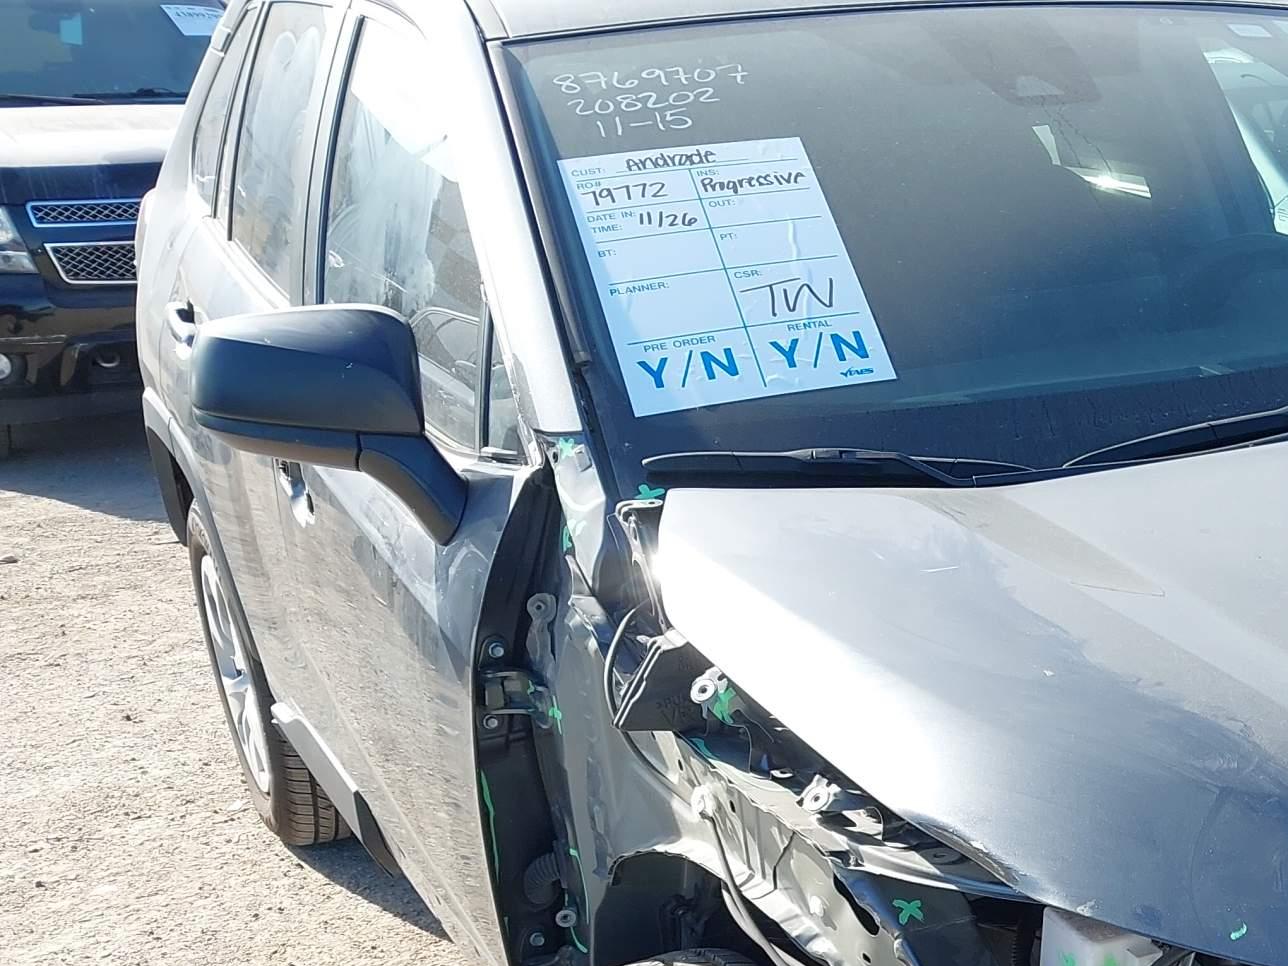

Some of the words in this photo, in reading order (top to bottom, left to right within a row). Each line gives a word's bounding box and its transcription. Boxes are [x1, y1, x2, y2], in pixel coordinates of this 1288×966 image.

[552, 63, 749, 94] 8769707
[567, 87, 720, 116] 208202
[596, 108, 693, 138] 11-15
[625, 148, 717, 172] Andrade
[570, 167, 606, 177] CUST:
[696, 168, 720, 177] INS:
[576, 181, 602, 191] RO#
[580, 181, 669, 207] 79772
[708, 199, 736, 208] OUT:
[587, 213, 616, 223] DATE
[621, 210, 636, 219] IN:
[638, 210, 698, 228] 11/26
[591, 224, 623, 234] TIME:
[720, 232, 737, 241] PT:
[597, 249, 617, 258] BT:
[733, 269, 763, 279] CSR:
[609, 281, 670, 297] PLANNER:
[787, 319, 833, 332] RENTAL
[643, 342, 668, 353] PRE
[672, 335, 716, 348] ORDER
